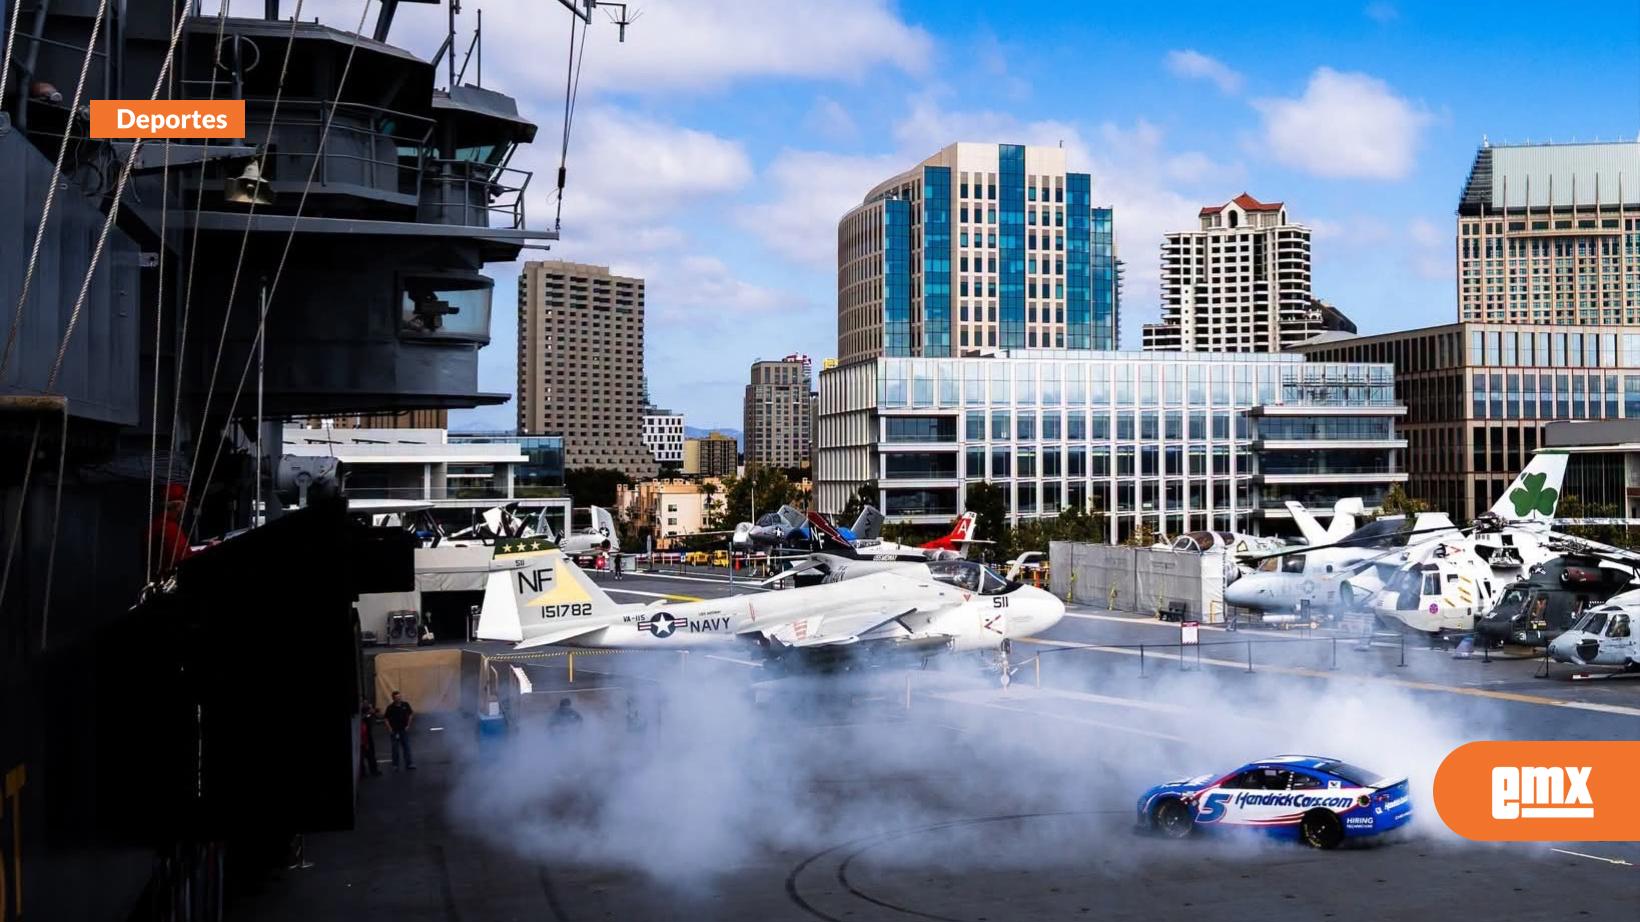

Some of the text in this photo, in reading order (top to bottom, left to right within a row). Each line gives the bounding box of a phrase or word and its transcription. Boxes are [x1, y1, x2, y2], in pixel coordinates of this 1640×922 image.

[957, 519, 968, 535] A
[518, 568, 553, 594] NF
[993, 596, 1009, 608] 511
[541, 603, 592, 619] 151782
[622, 614, 646, 622] VA-115
[690, 617, 730, 632] NAVY
[1195, 791, 1354, 823] 5 HendrickCars.com
